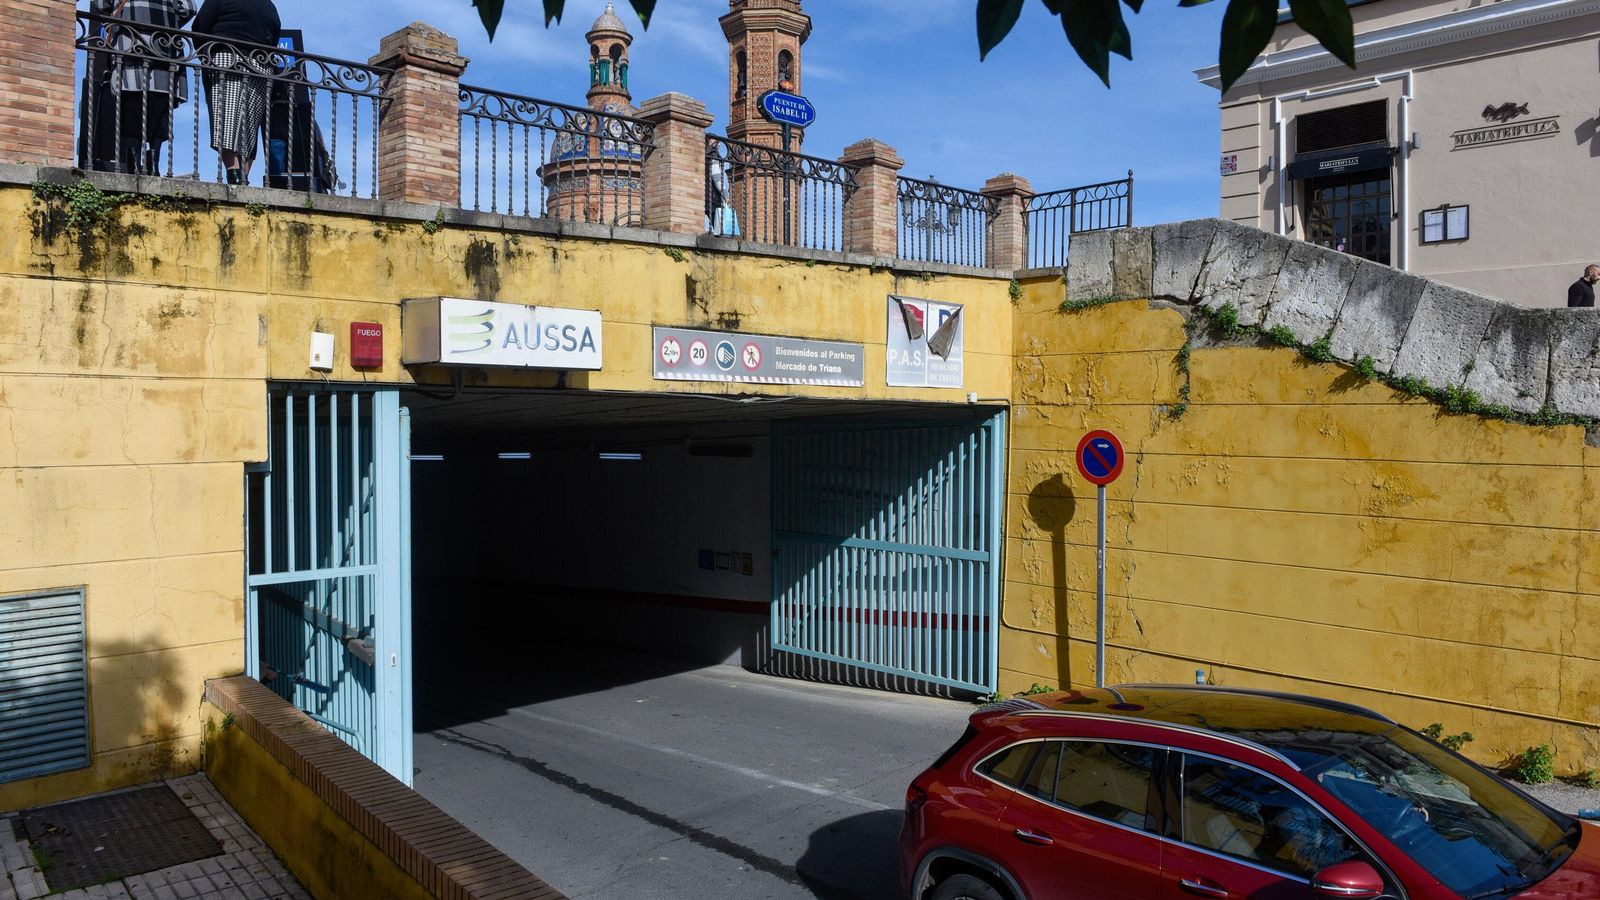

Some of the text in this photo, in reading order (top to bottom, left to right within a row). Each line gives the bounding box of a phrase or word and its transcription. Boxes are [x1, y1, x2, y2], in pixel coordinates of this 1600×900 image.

[774, 98, 797, 108] PUENTE
[772, 104, 807, 120] ISABEL II
[357, 329, 381, 337] FUEGO
[502, 322, 597, 353] AUSSA
[693, 348, 705, 359] 20
[775, 346, 855, 362] Bienvenidos al Parking
[889, 349, 924, 367] P.A.S.
[775, 361, 842, 373] Mercado de Triana
